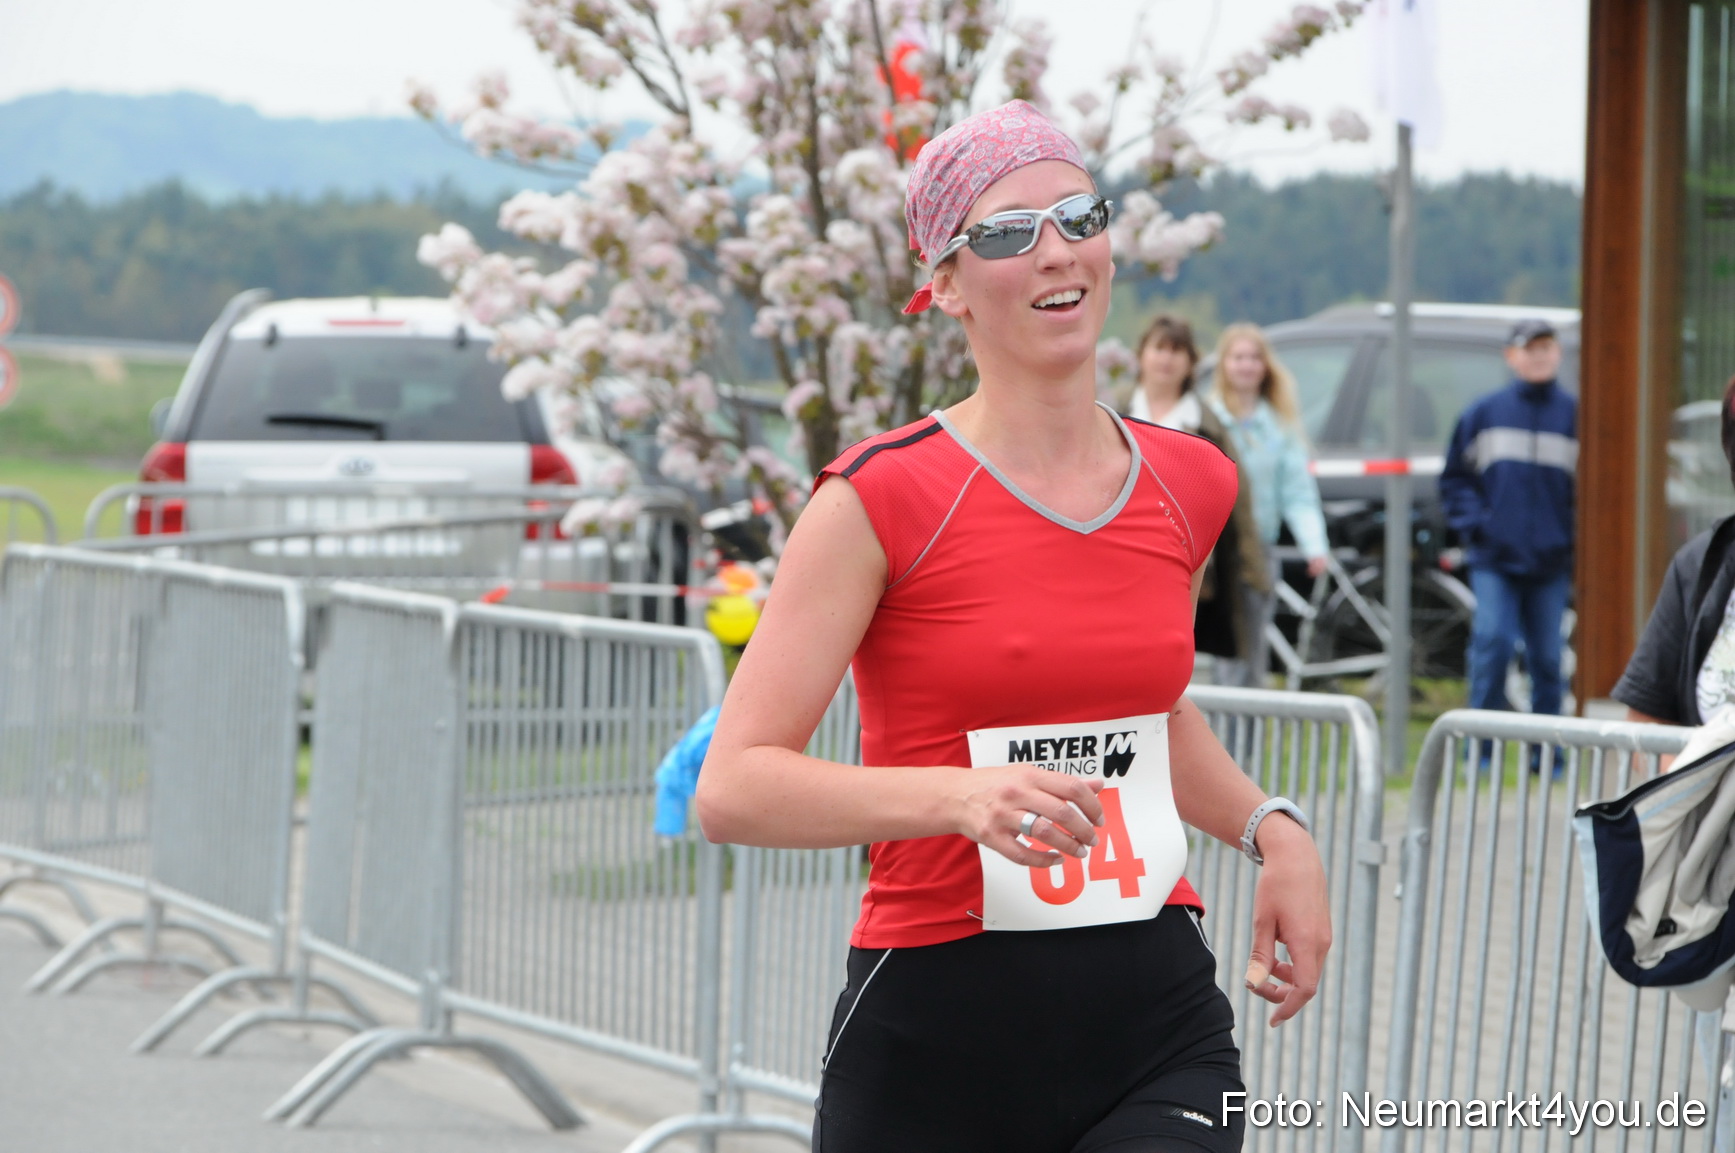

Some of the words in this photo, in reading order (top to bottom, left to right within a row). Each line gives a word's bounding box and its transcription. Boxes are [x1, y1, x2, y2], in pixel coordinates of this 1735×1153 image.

[1008, 735, 1098, 763] MEYER
[1031, 759, 1097, 776] BUNG
[1182, 1110, 1214, 1127] adidas
